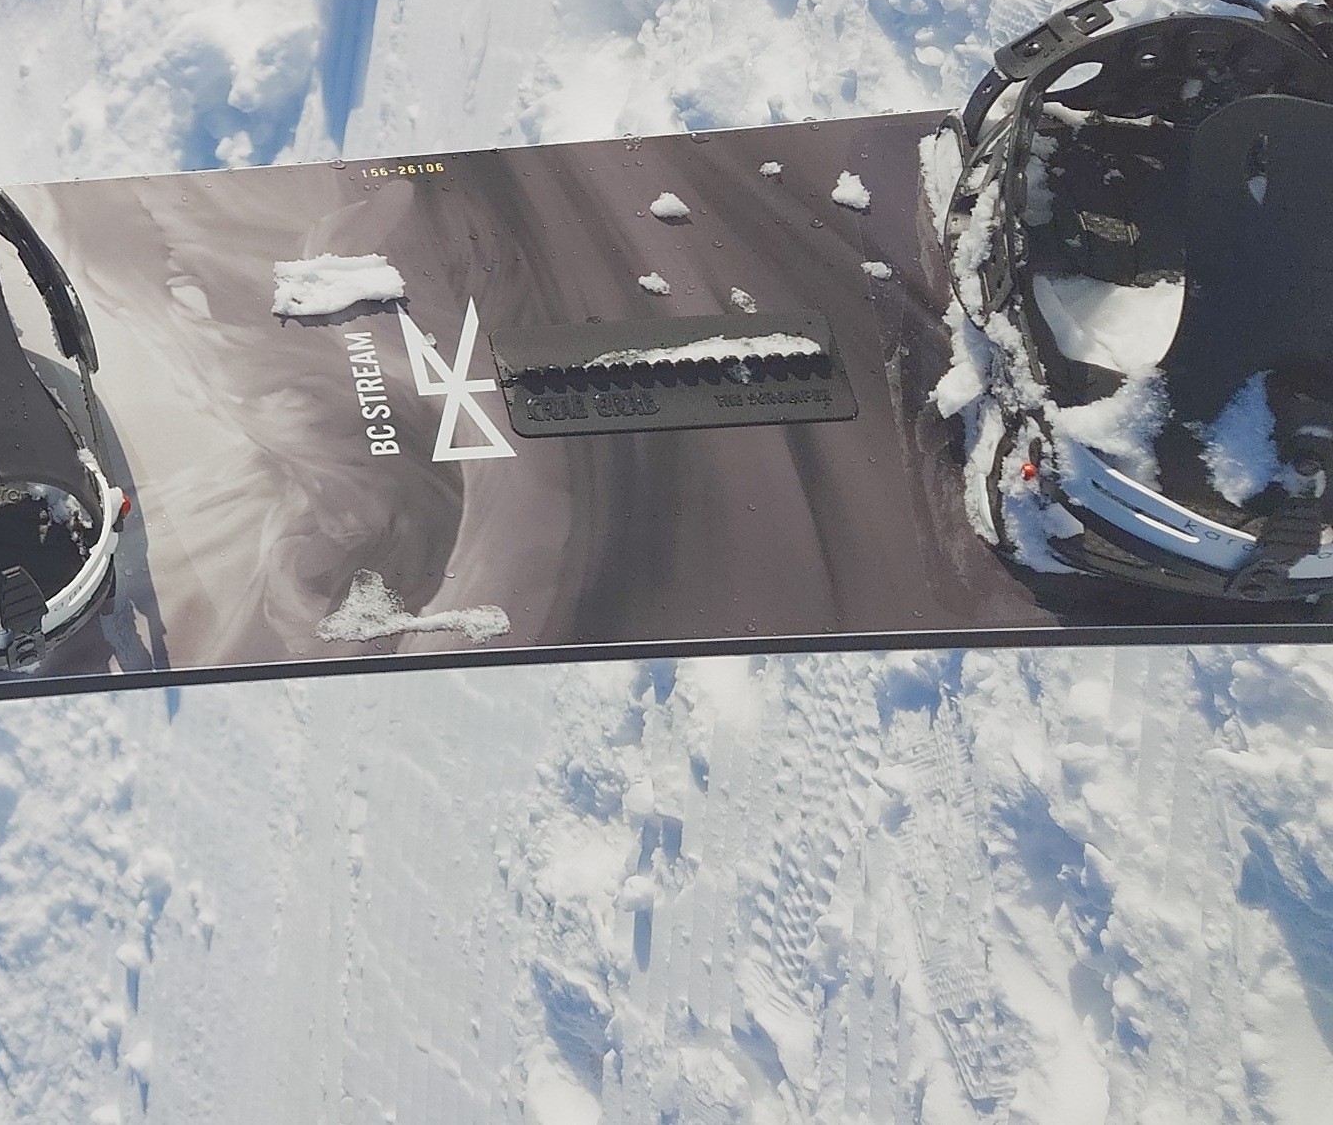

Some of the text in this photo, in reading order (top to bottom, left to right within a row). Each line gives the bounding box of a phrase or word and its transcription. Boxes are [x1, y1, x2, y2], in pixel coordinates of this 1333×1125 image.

[361, 162, 445, 178] 156-26106
[344, 331, 401, 456] BC STREAM
